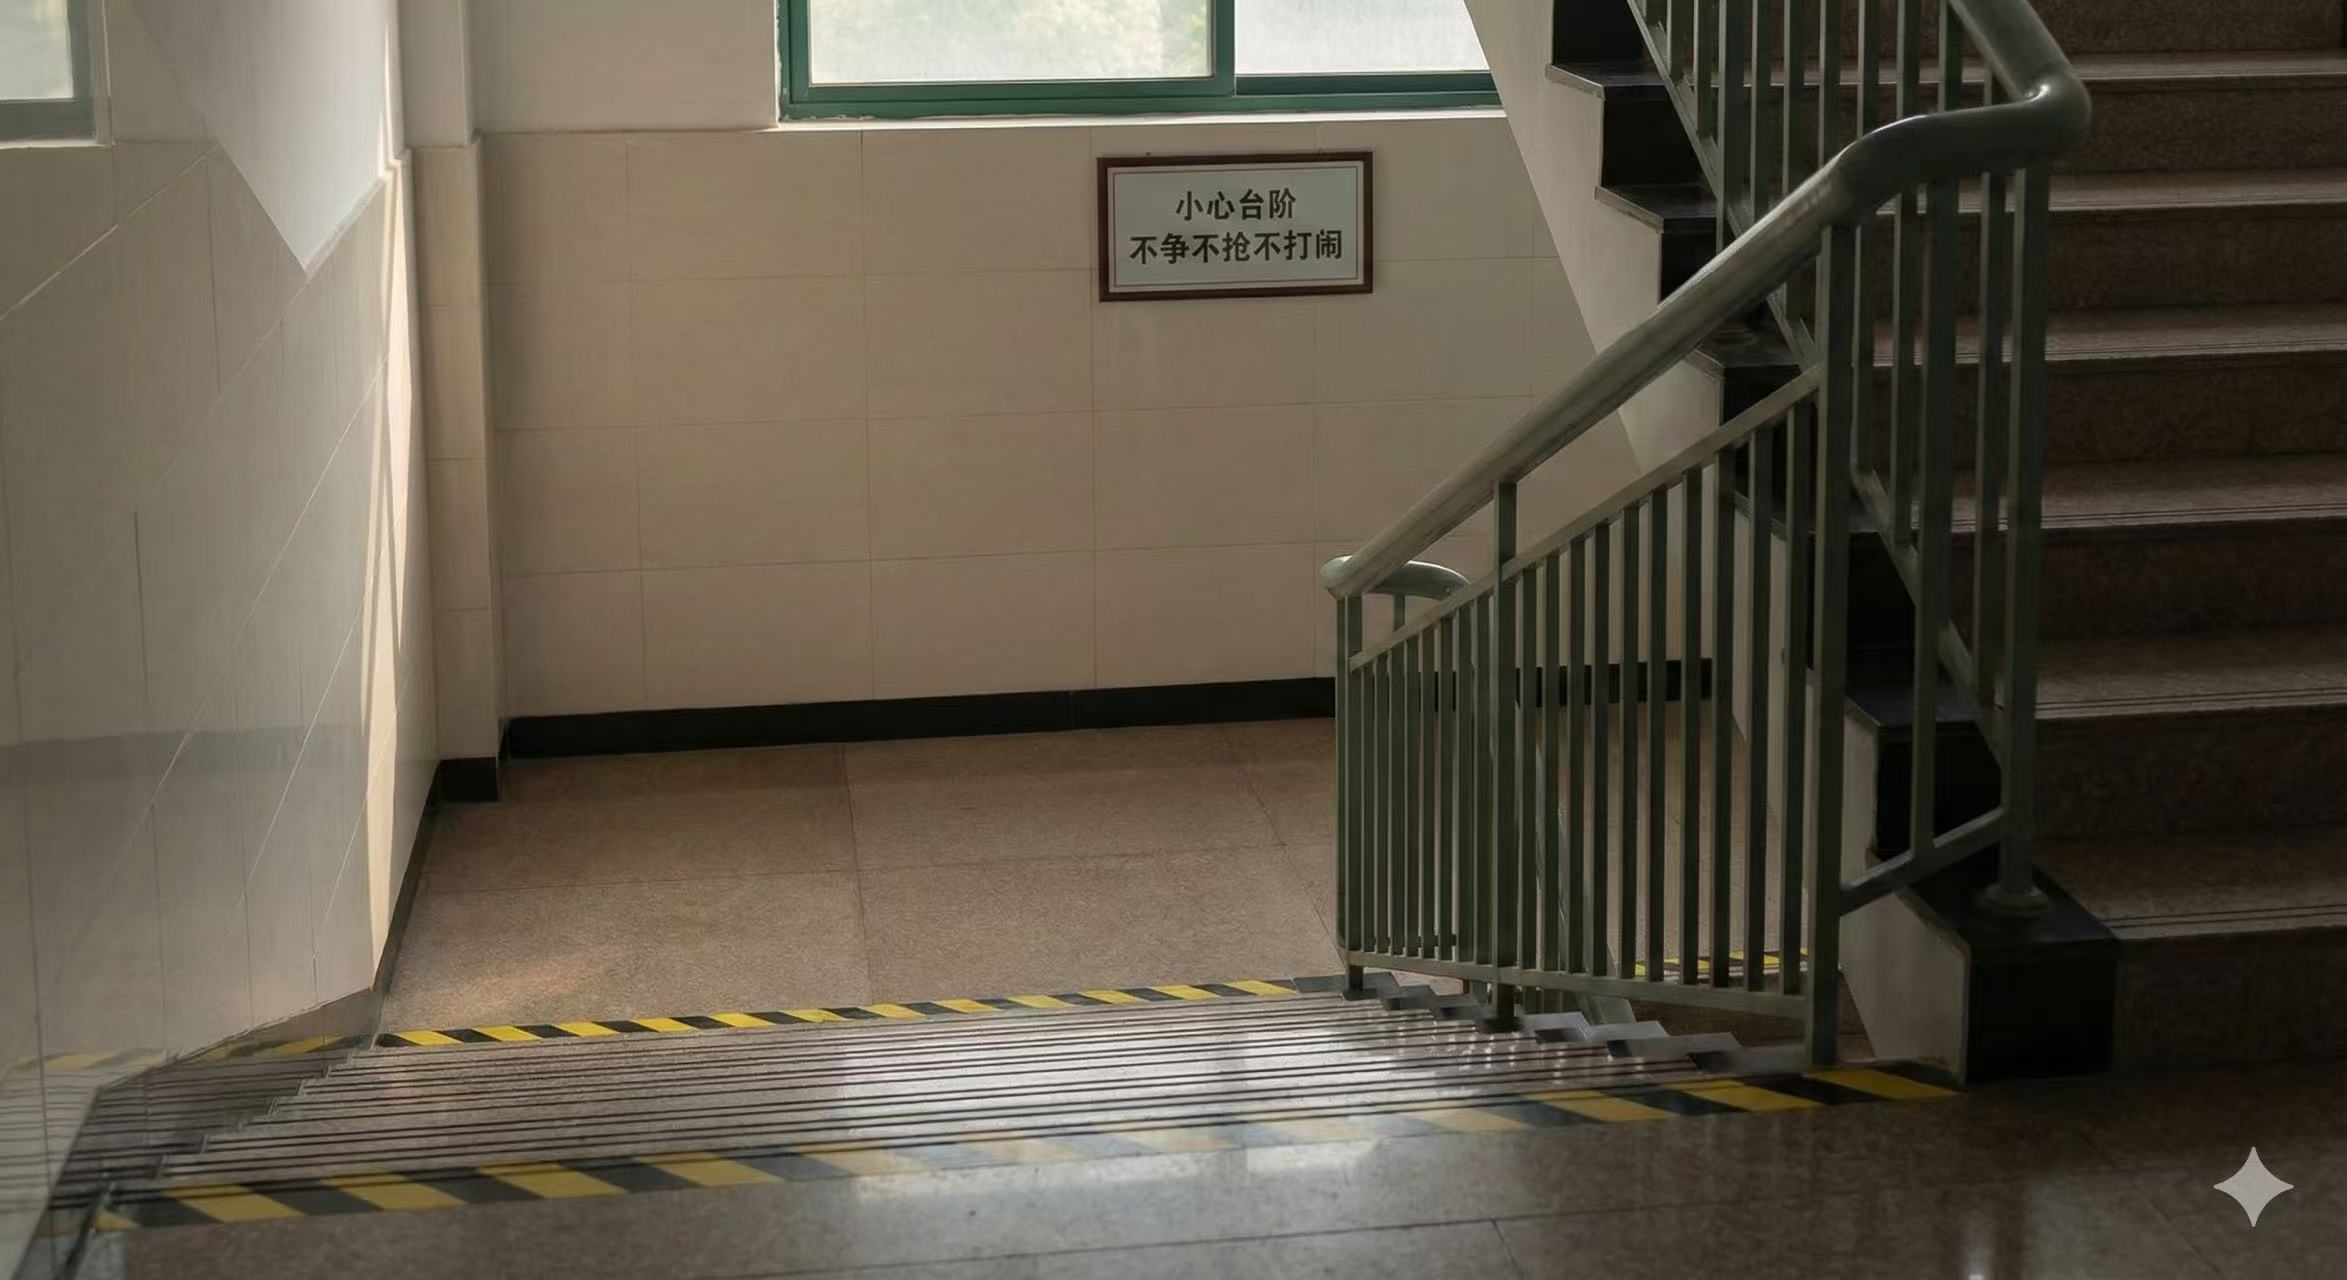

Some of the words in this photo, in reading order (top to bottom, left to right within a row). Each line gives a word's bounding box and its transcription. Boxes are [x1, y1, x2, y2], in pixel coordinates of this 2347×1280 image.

[1175, 187, 1297, 222] 小心台阶
[1129, 228, 1343, 265] 不争不抢不打闹
